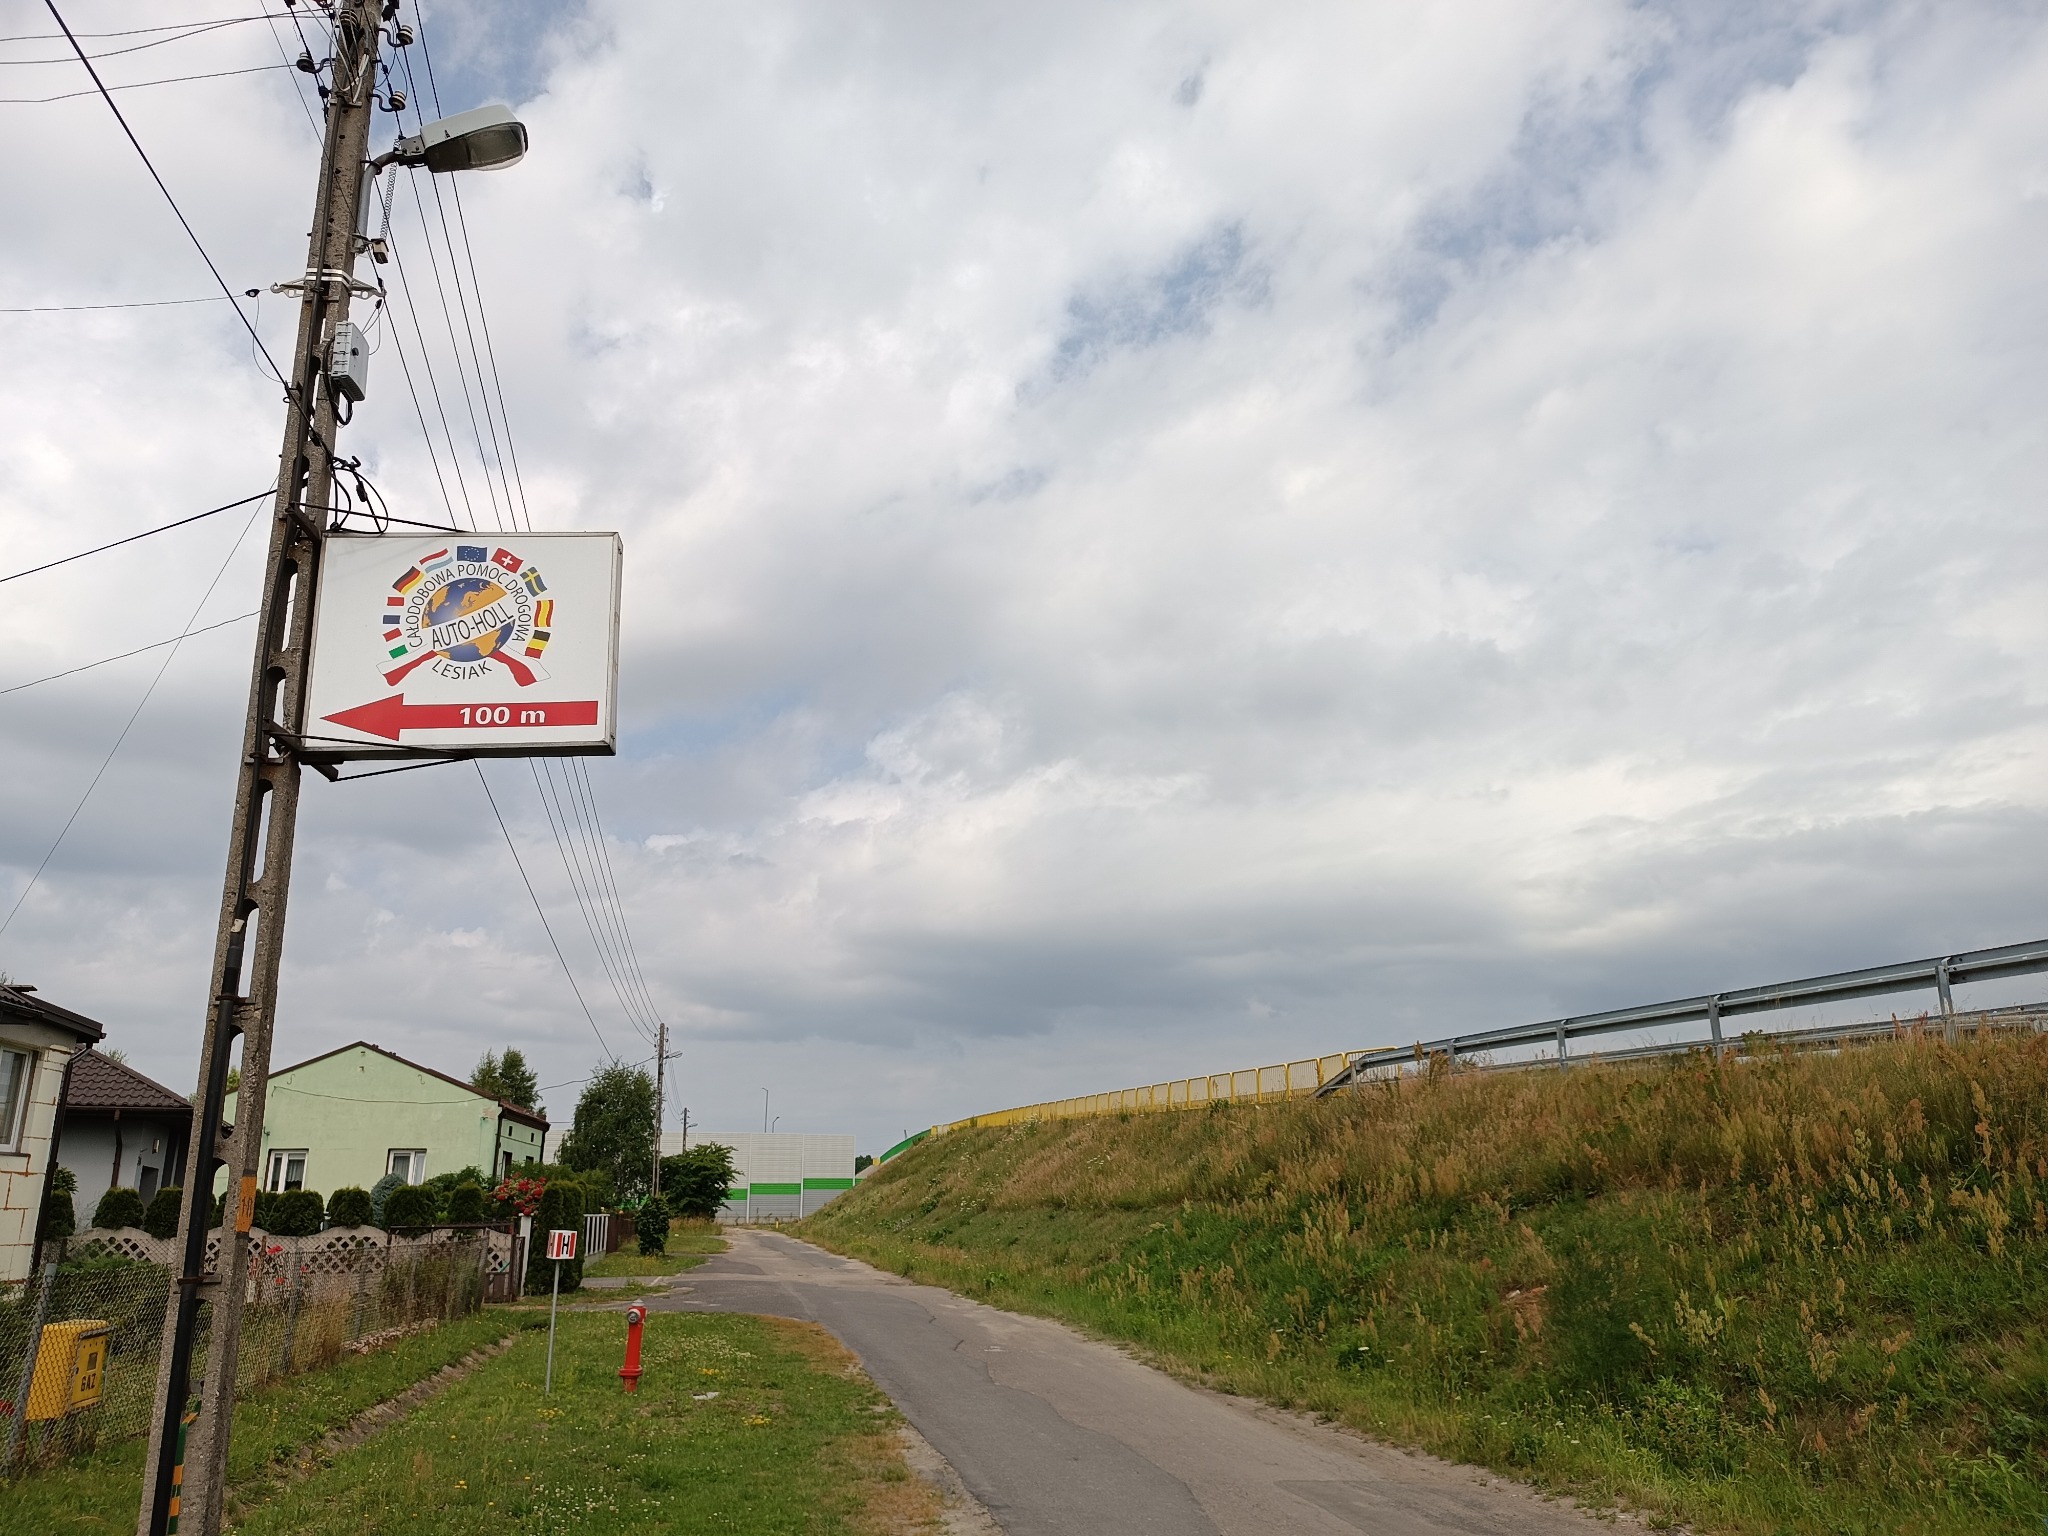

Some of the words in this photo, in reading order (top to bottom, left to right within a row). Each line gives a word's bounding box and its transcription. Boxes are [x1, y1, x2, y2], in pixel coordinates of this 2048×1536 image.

[405, 568, 456, 648] CAŁODOBOWA
[457, 563, 509, 585] POMOC
[504, 579, 532, 642] DROGOWA
[432, 602, 514, 649] AUTO-HOLL
[431, 659, 493, 680] LESIAK
[459, 706, 510, 725] 100
[520, 708, 546, 724] m
[562, 1235, 570, 1254] H
[81, 1373, 96, 1391] GAZ
